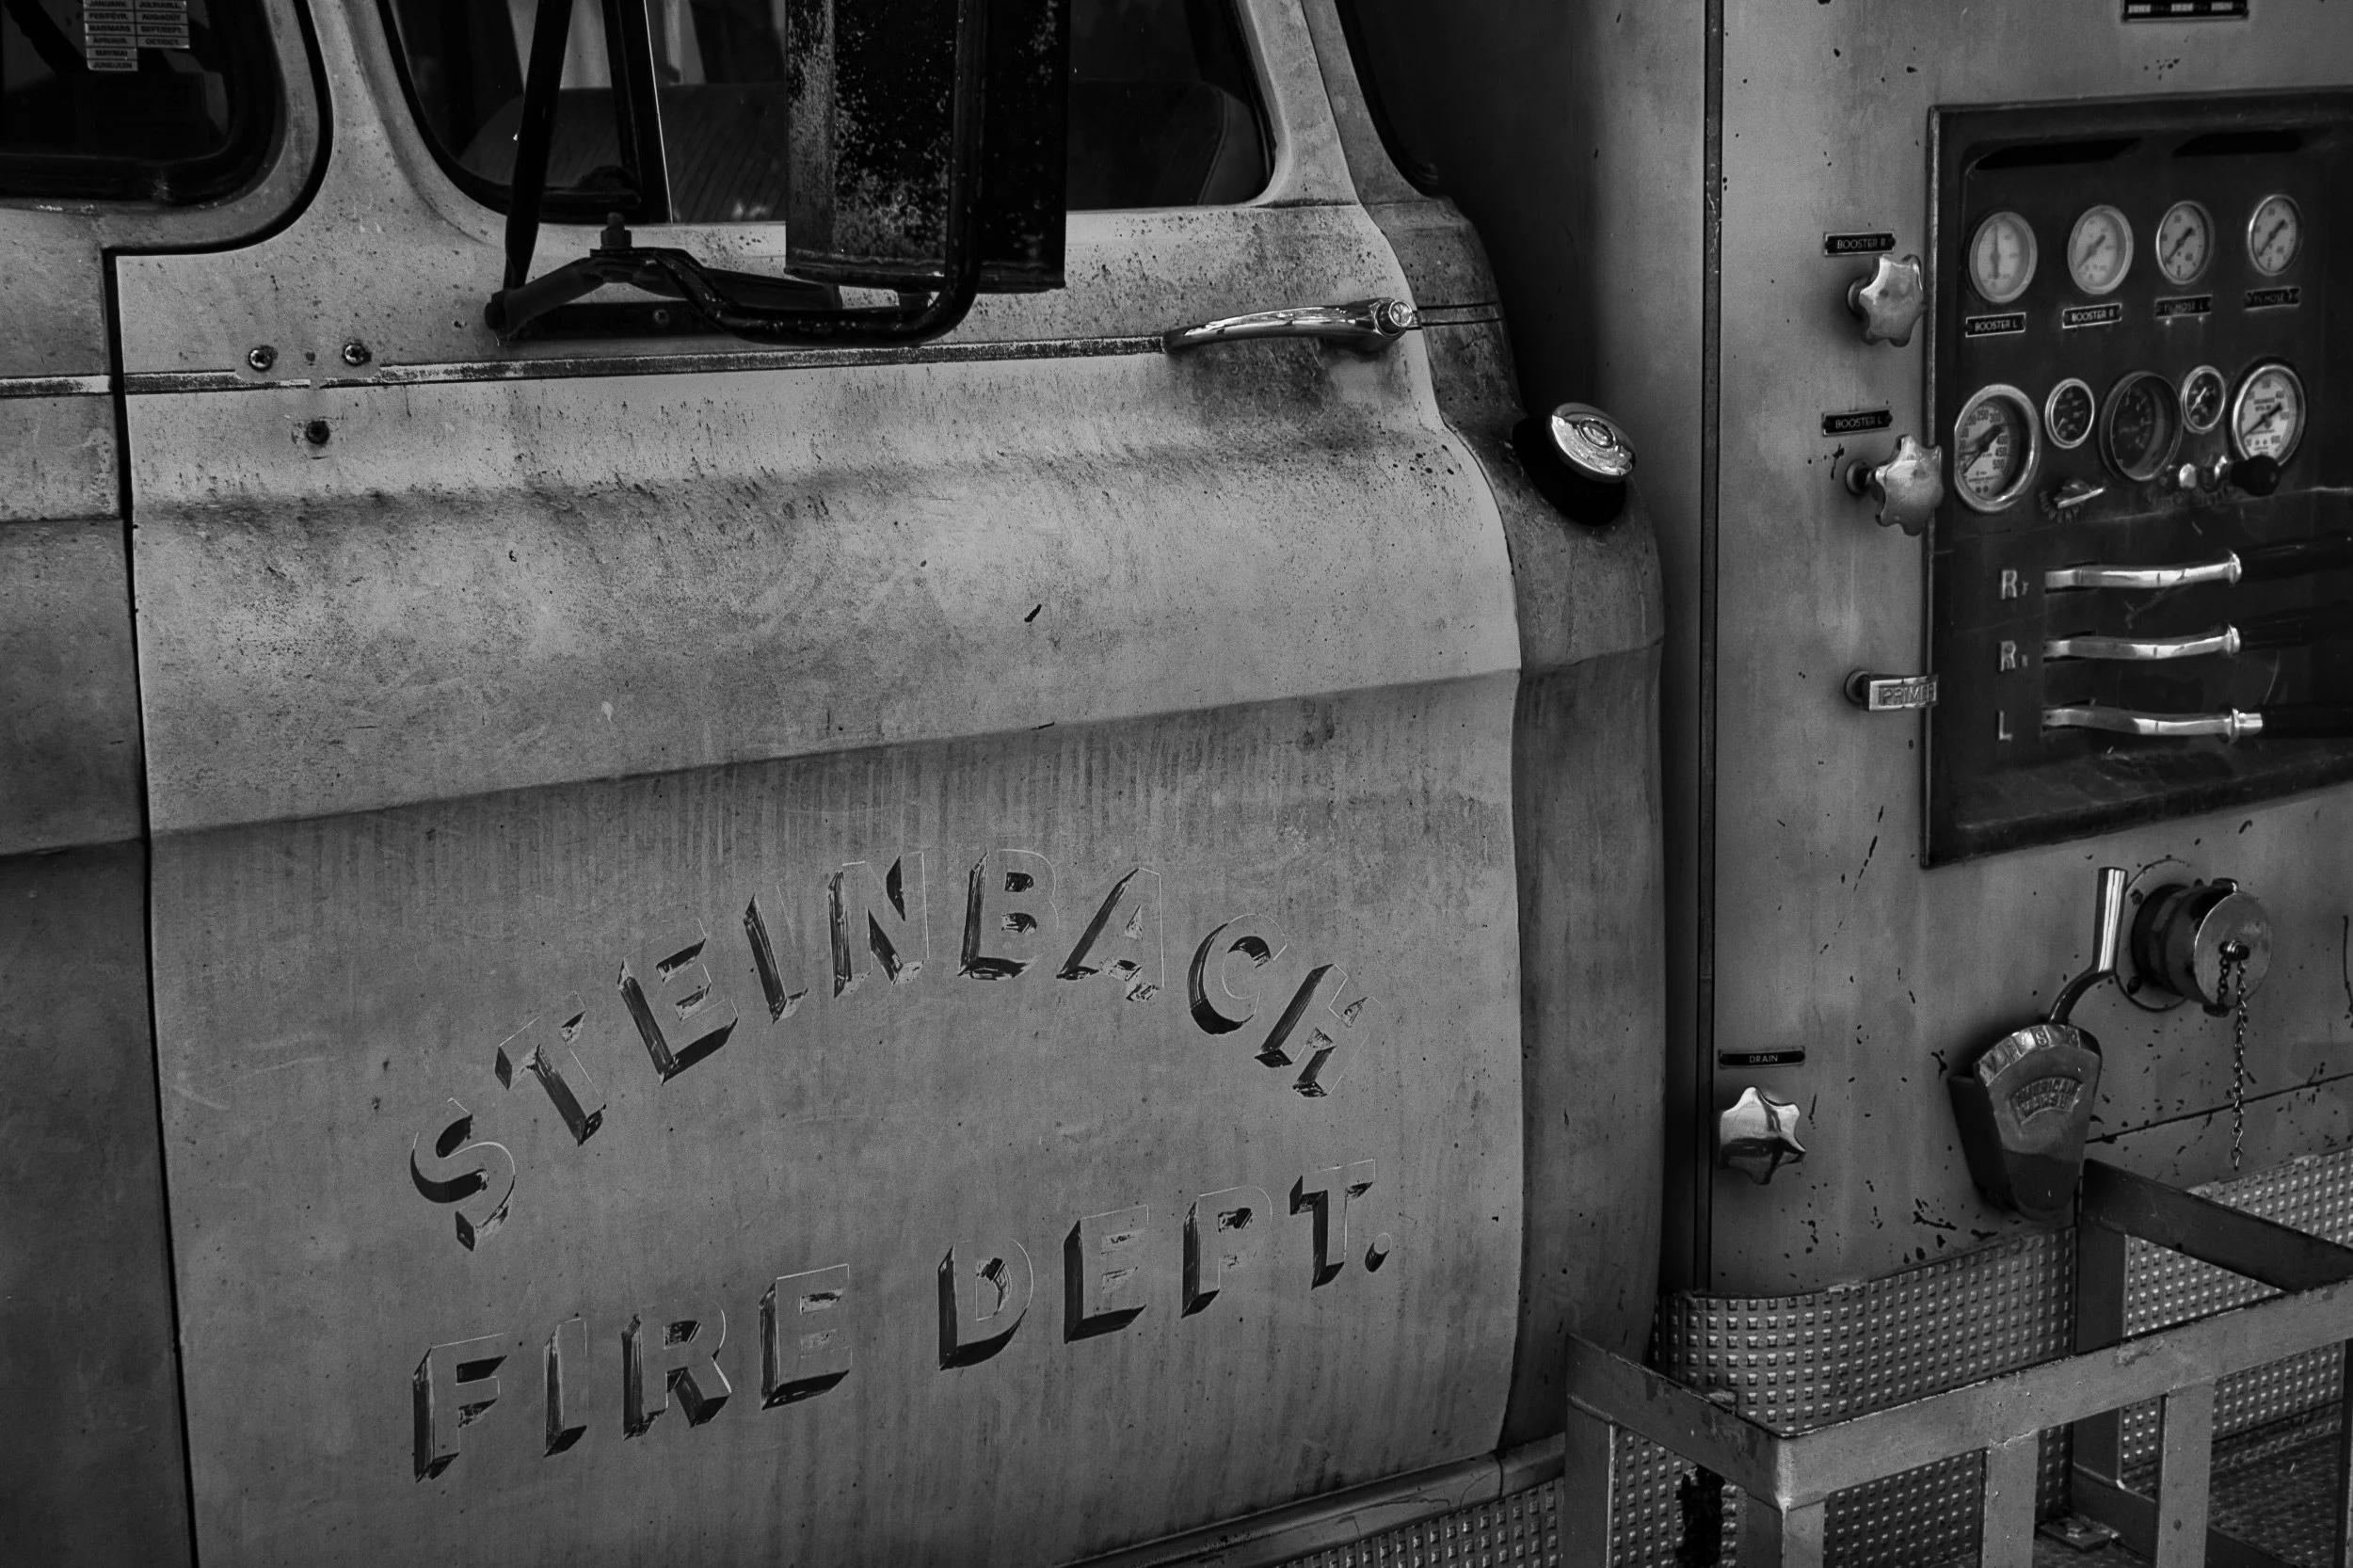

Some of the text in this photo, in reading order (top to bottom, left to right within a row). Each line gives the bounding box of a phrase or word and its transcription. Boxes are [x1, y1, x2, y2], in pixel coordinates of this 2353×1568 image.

[1837, 237, 1886, 249] BOOSTER R
[2072, 308, 2115, 322] BOOSTER R
[1975, 319, 2018, 332] BOOSTER L
[1977, 408, 1990, 422] 250
[1835, 416, 1876, 429] BOOSTER
[1998, 710, 2013, 742] L
[410, 849, 1384, 1252] STEINBACH
[1749, 1054, 1778, 1064] DRAIN
[413, 1158, 1392, 1483] FIRE DEPT.
